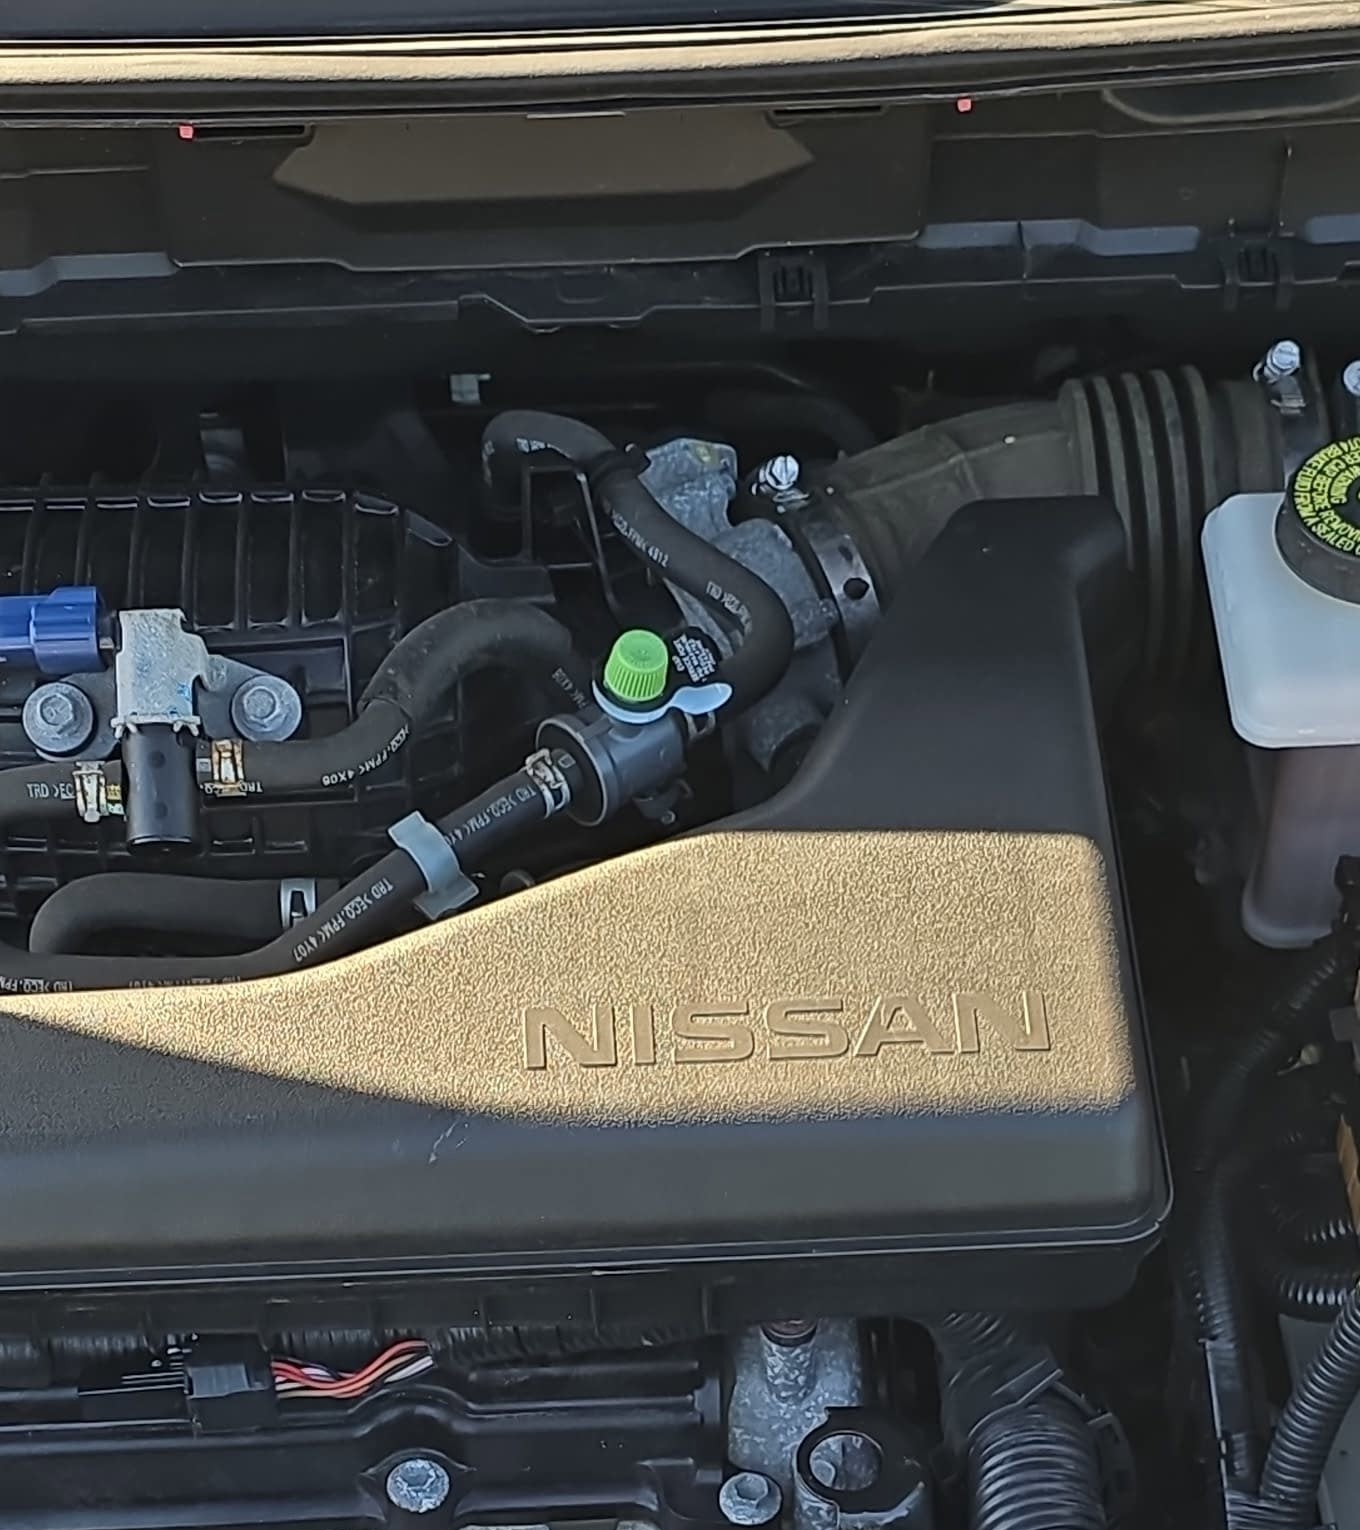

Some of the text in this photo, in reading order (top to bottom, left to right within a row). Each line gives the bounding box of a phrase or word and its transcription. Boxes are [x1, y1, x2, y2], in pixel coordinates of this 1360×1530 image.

[1305, 442, 1341, 466] BRAKE
[1312, 523, 1354, 551] SEALED
[27, 783, 49, 799] TRD
[371, 877, 393, 900] TRD
[524, 990, 1051, 1070] NISSAN
